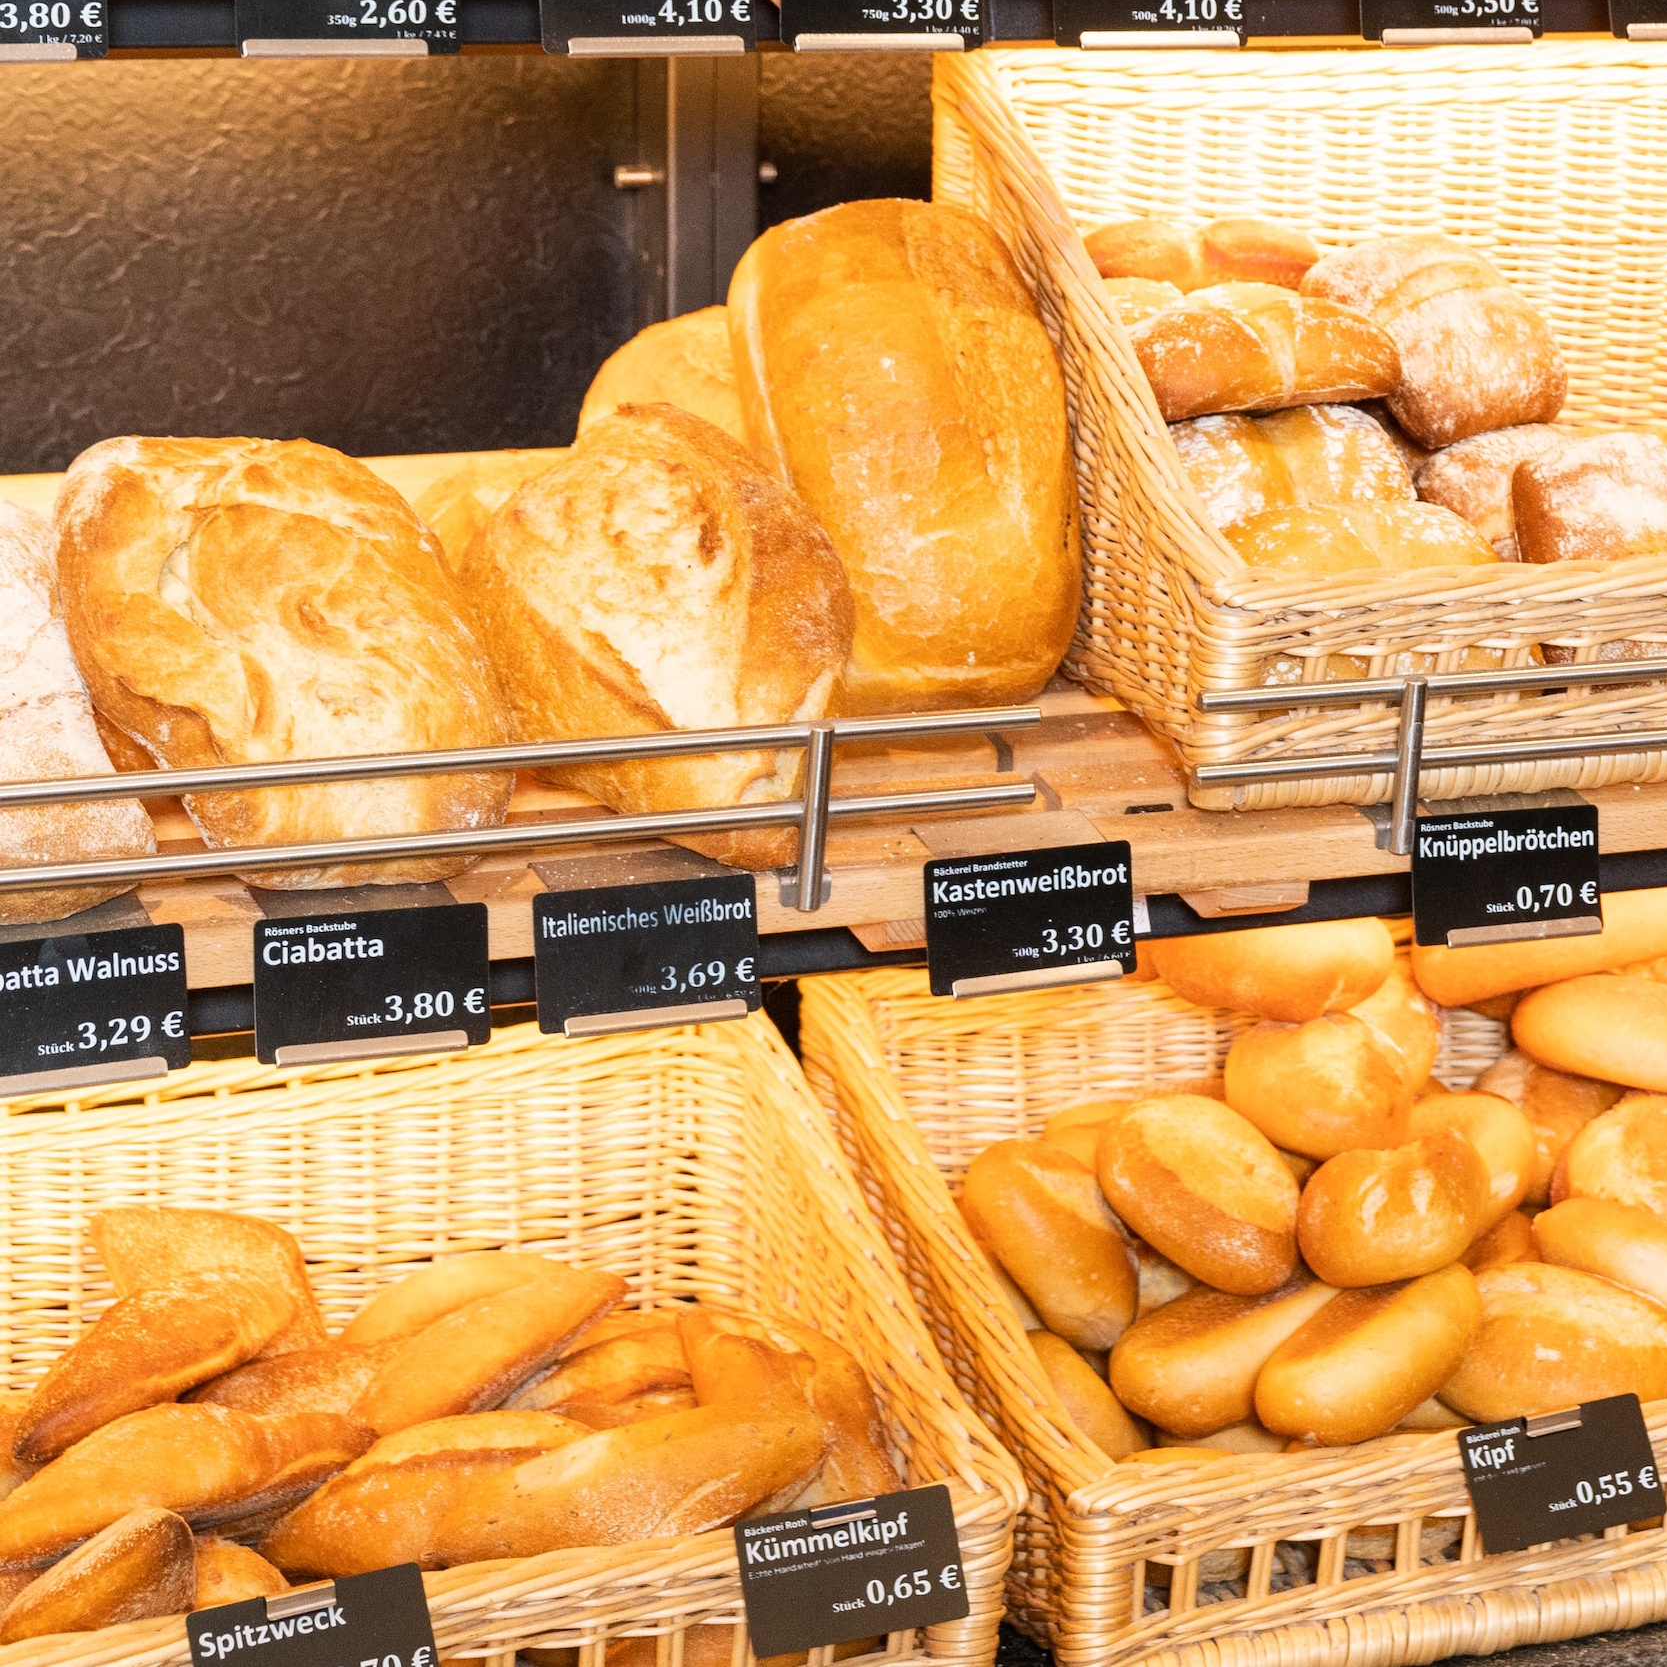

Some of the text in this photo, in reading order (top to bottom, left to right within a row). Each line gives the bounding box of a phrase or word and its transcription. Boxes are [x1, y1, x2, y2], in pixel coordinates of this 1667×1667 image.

[0, 1, 103, 33] 3,80 €
[327, 0, 457, 29] 350g 2,60 €
[621, 14, 656, 26] 1000g
[862, 9, 890, 22] 750g
[1131, 10, 1158, 22] 500g
[1434, 4, 1459, 16] 500g
[1420, 819, 1495, 832] Rösners Backstube
[1419, 826, 1595, 861] Knüppelbrötchen
[933, 859, 1029, 877] Bäckerei Brandstetter
[933, 863, 1128, 904] Kastenweißbrot
[1486, 880, 1598, 914] Stück 0,70 €
[264, 921, 357, 937] Rösners Backstube
[542, 897, 752, 939] Italienisches Weißbrot
[262, 936, 384, 967] Ciabatta
[1012, 920, 1132, 959] 500g 3,30 €
[66, 951, 180, 983] Walnuss
[660, 956, 756, 994] 3,69 €
[346, 987, 486, 1027] Stück 3,80 €
[37, 1010, 185, 1056] Stück 3,29 €
[1466, 1425, 1521, 1444] Bäckerei Roth
[1468, 1439, 1516, 1469] Kipf
[1548, 1497, 1578, 1513] Stück
[1576, 1470, 1633, 1506] 0,55
[1638, 1465, 1658, 1490] €
[744, 1518, 808, 1538] Bäckerei Roth
[745, 1511, 909, 1565] Kümmelkipf
[841, 1551, 864, 1561] Hand
[832, 1564, 962, 1613] Stück 0,65 €
[198, 1605, 347, 1660] Spitzweck
